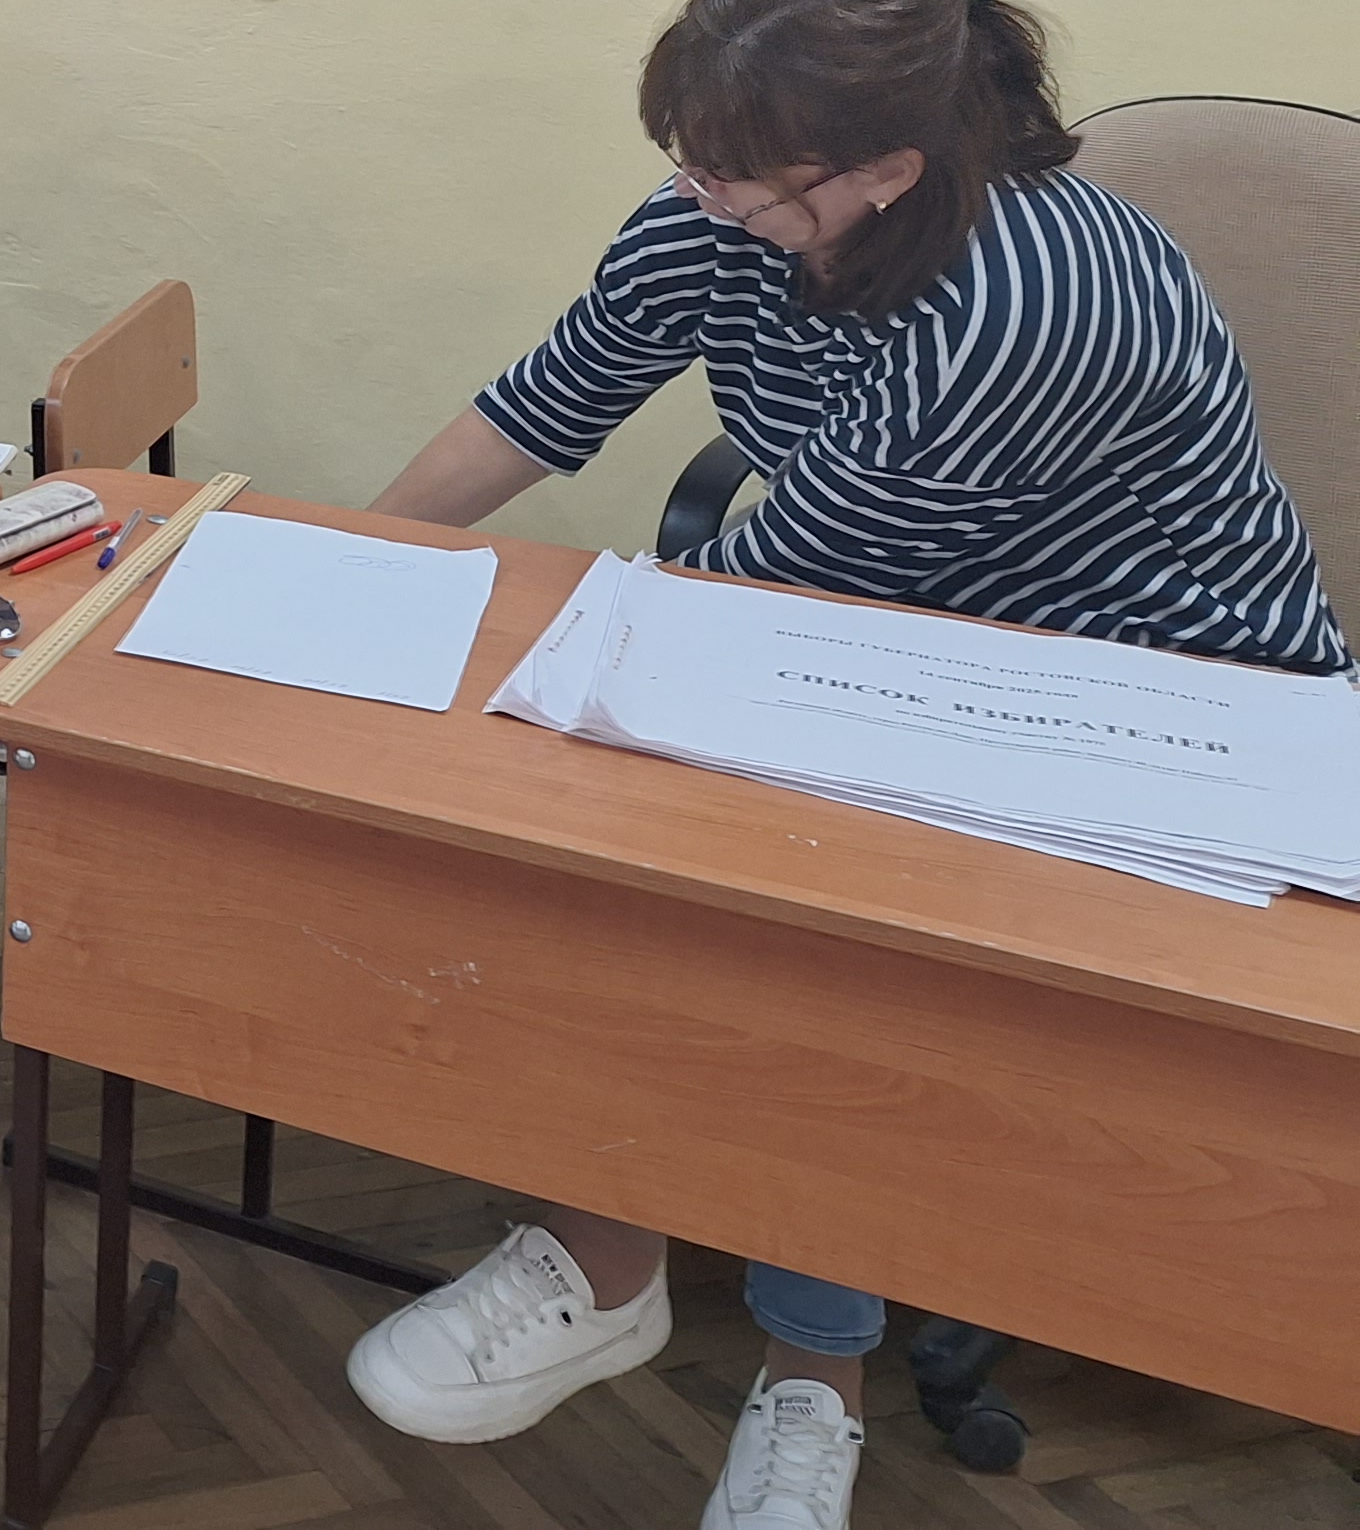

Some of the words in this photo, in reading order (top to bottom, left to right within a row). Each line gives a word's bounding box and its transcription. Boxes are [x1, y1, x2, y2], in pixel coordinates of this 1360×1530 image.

[776, 629, 853, 646] ВЫБОРЫ
[859, 642, 992, 671] ГУБЕРНАТОРА
[999, 667, 1129, 689] РОСТОВСКОЙ
[1136, 685, 1230, 708] ОБЛАСТИ
[776, 670, 931, 706] СПИСОК
[953, 702, 1230, 755] ИЗБИРАТЕЛЕЙ
